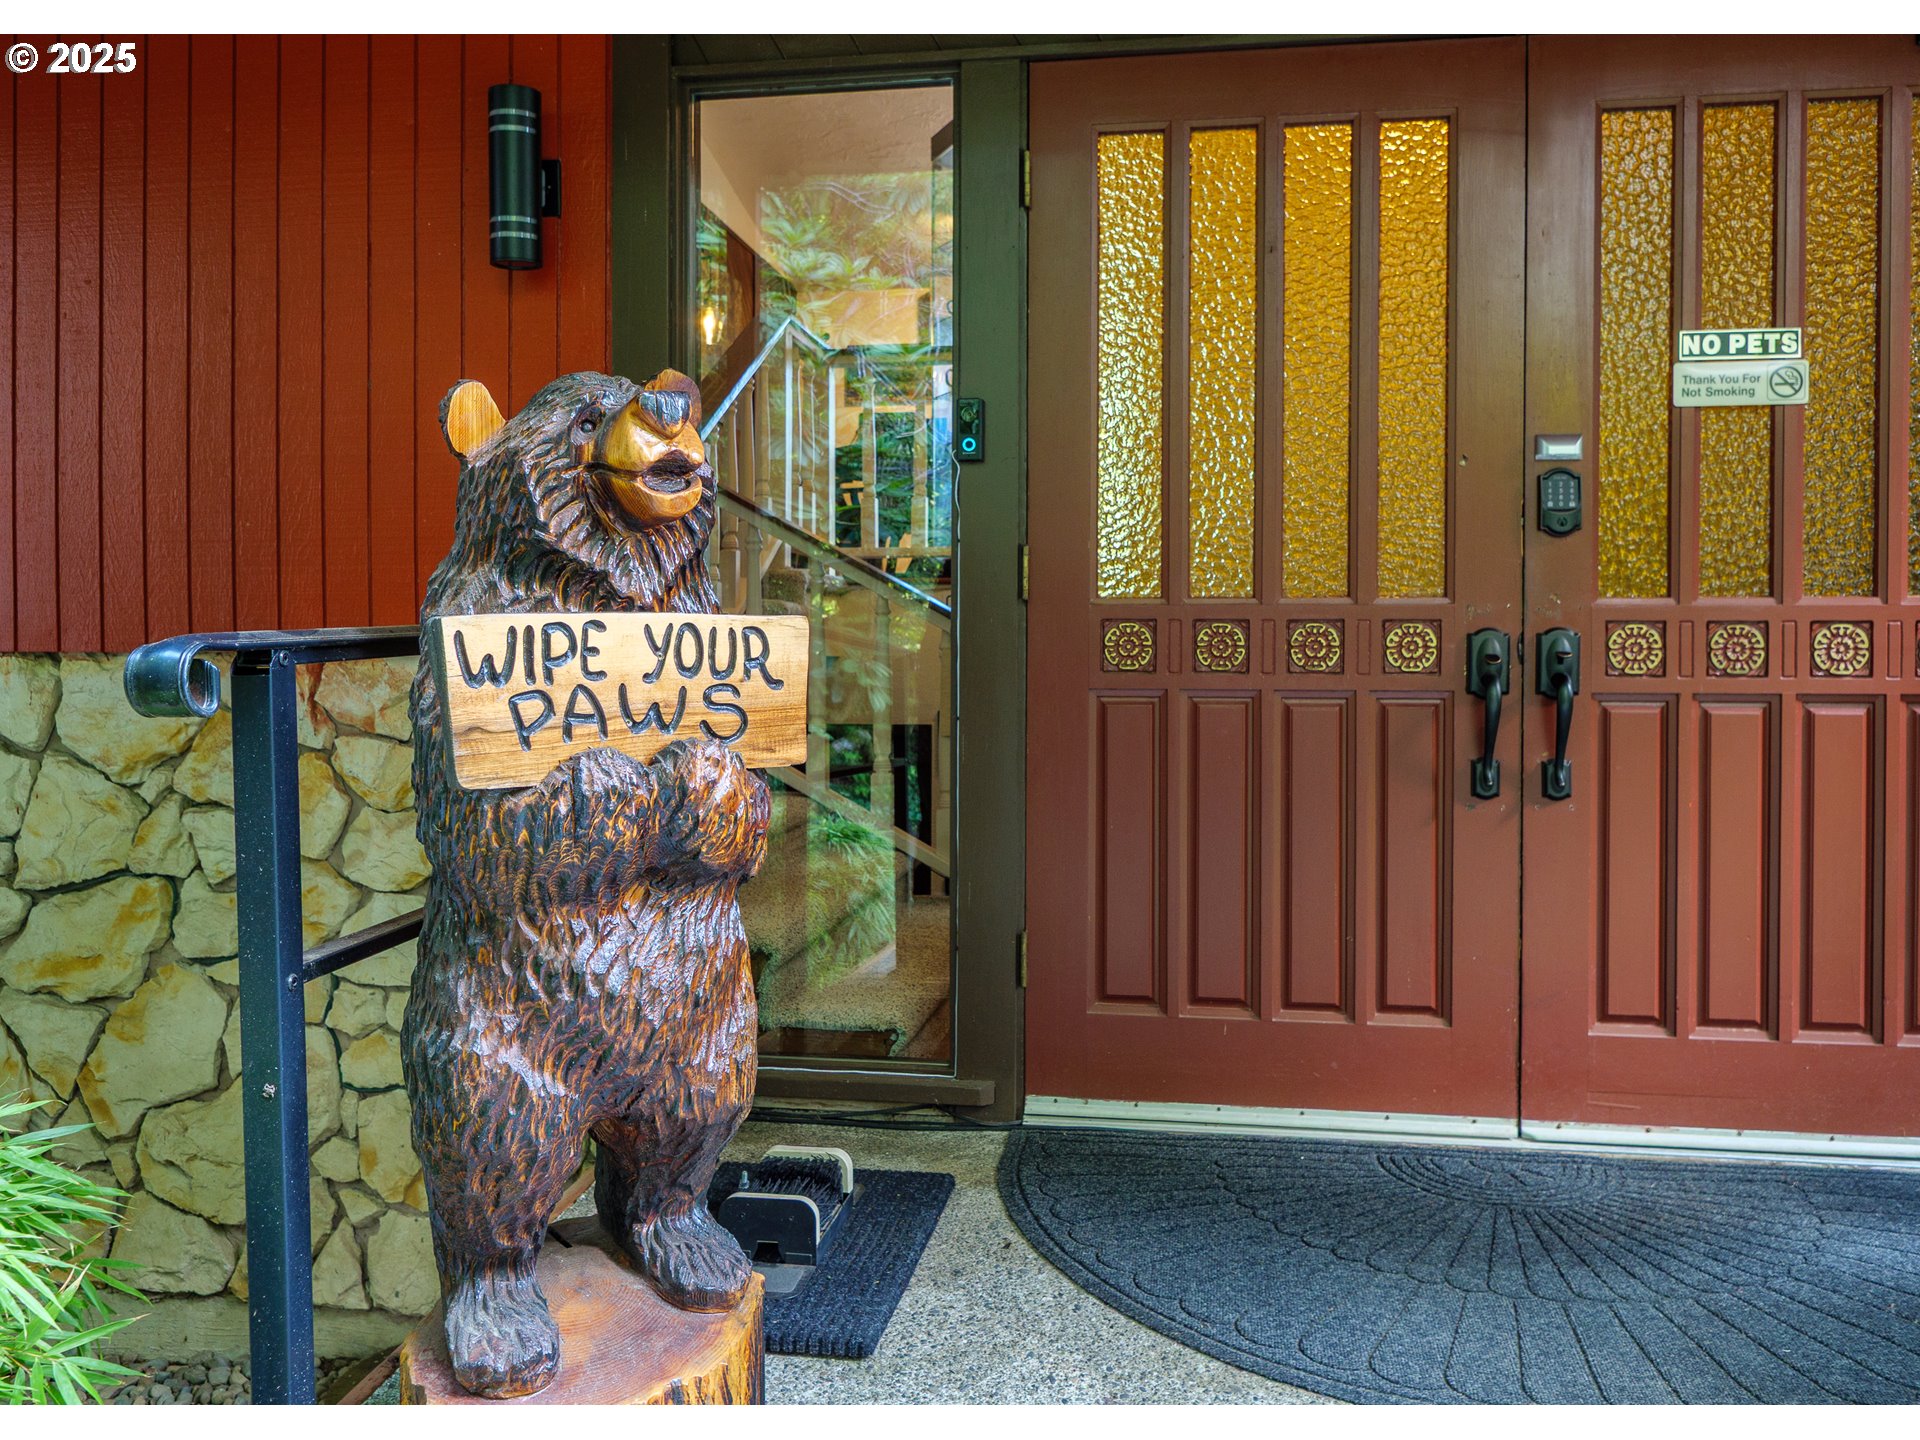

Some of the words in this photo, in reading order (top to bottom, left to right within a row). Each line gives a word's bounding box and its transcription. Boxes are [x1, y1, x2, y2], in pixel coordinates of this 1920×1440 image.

[1682, 333, 1722, 356] NO
[1728, 332, 1798, 354] PETS
[1682, 374, 1716, 385] Thank
[1718, 373, 1740, 385] You
[1742, 373, 1761, 384] For
[1681, 388, 1701, 398] Not
[1705, 386, 1756, 398] Smoking
[454, 619, 608, 690] WIPE
[641, 621, 785, 691] YOUR
[508, 682, 749, 753] PAWS
